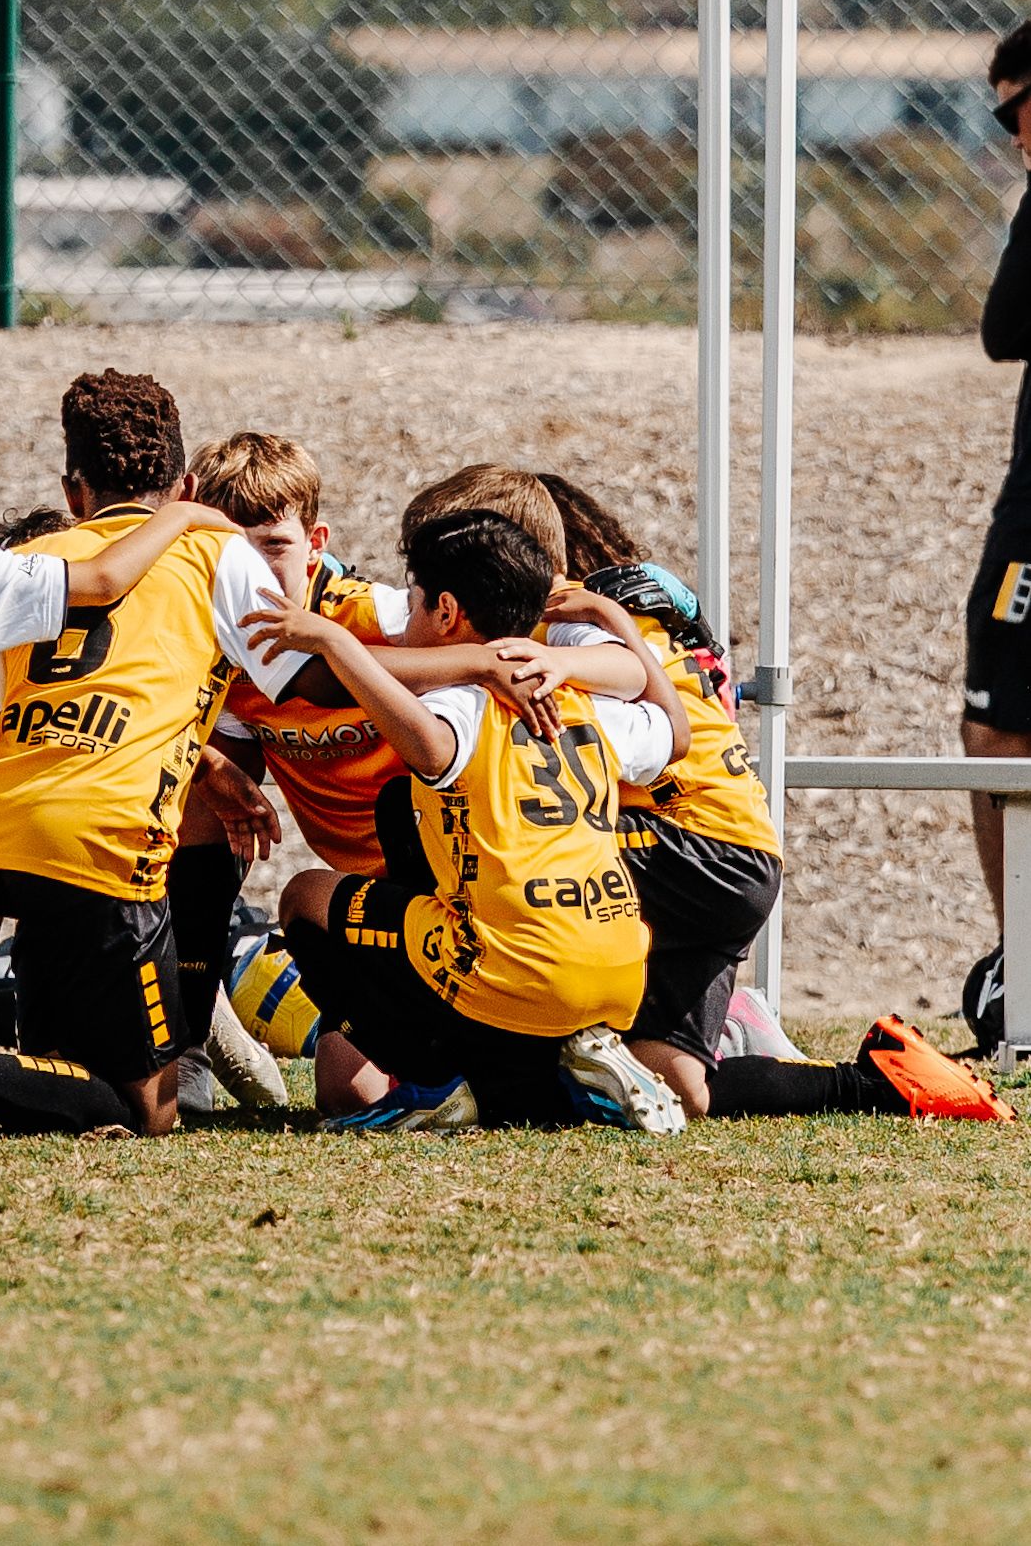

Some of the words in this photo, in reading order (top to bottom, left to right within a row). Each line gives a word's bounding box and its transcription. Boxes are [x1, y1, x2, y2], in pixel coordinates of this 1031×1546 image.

[28, 729, 117, 755] SPORT
[511, 719, 614, 832] 30
[524, 856, 634, 920] capel
